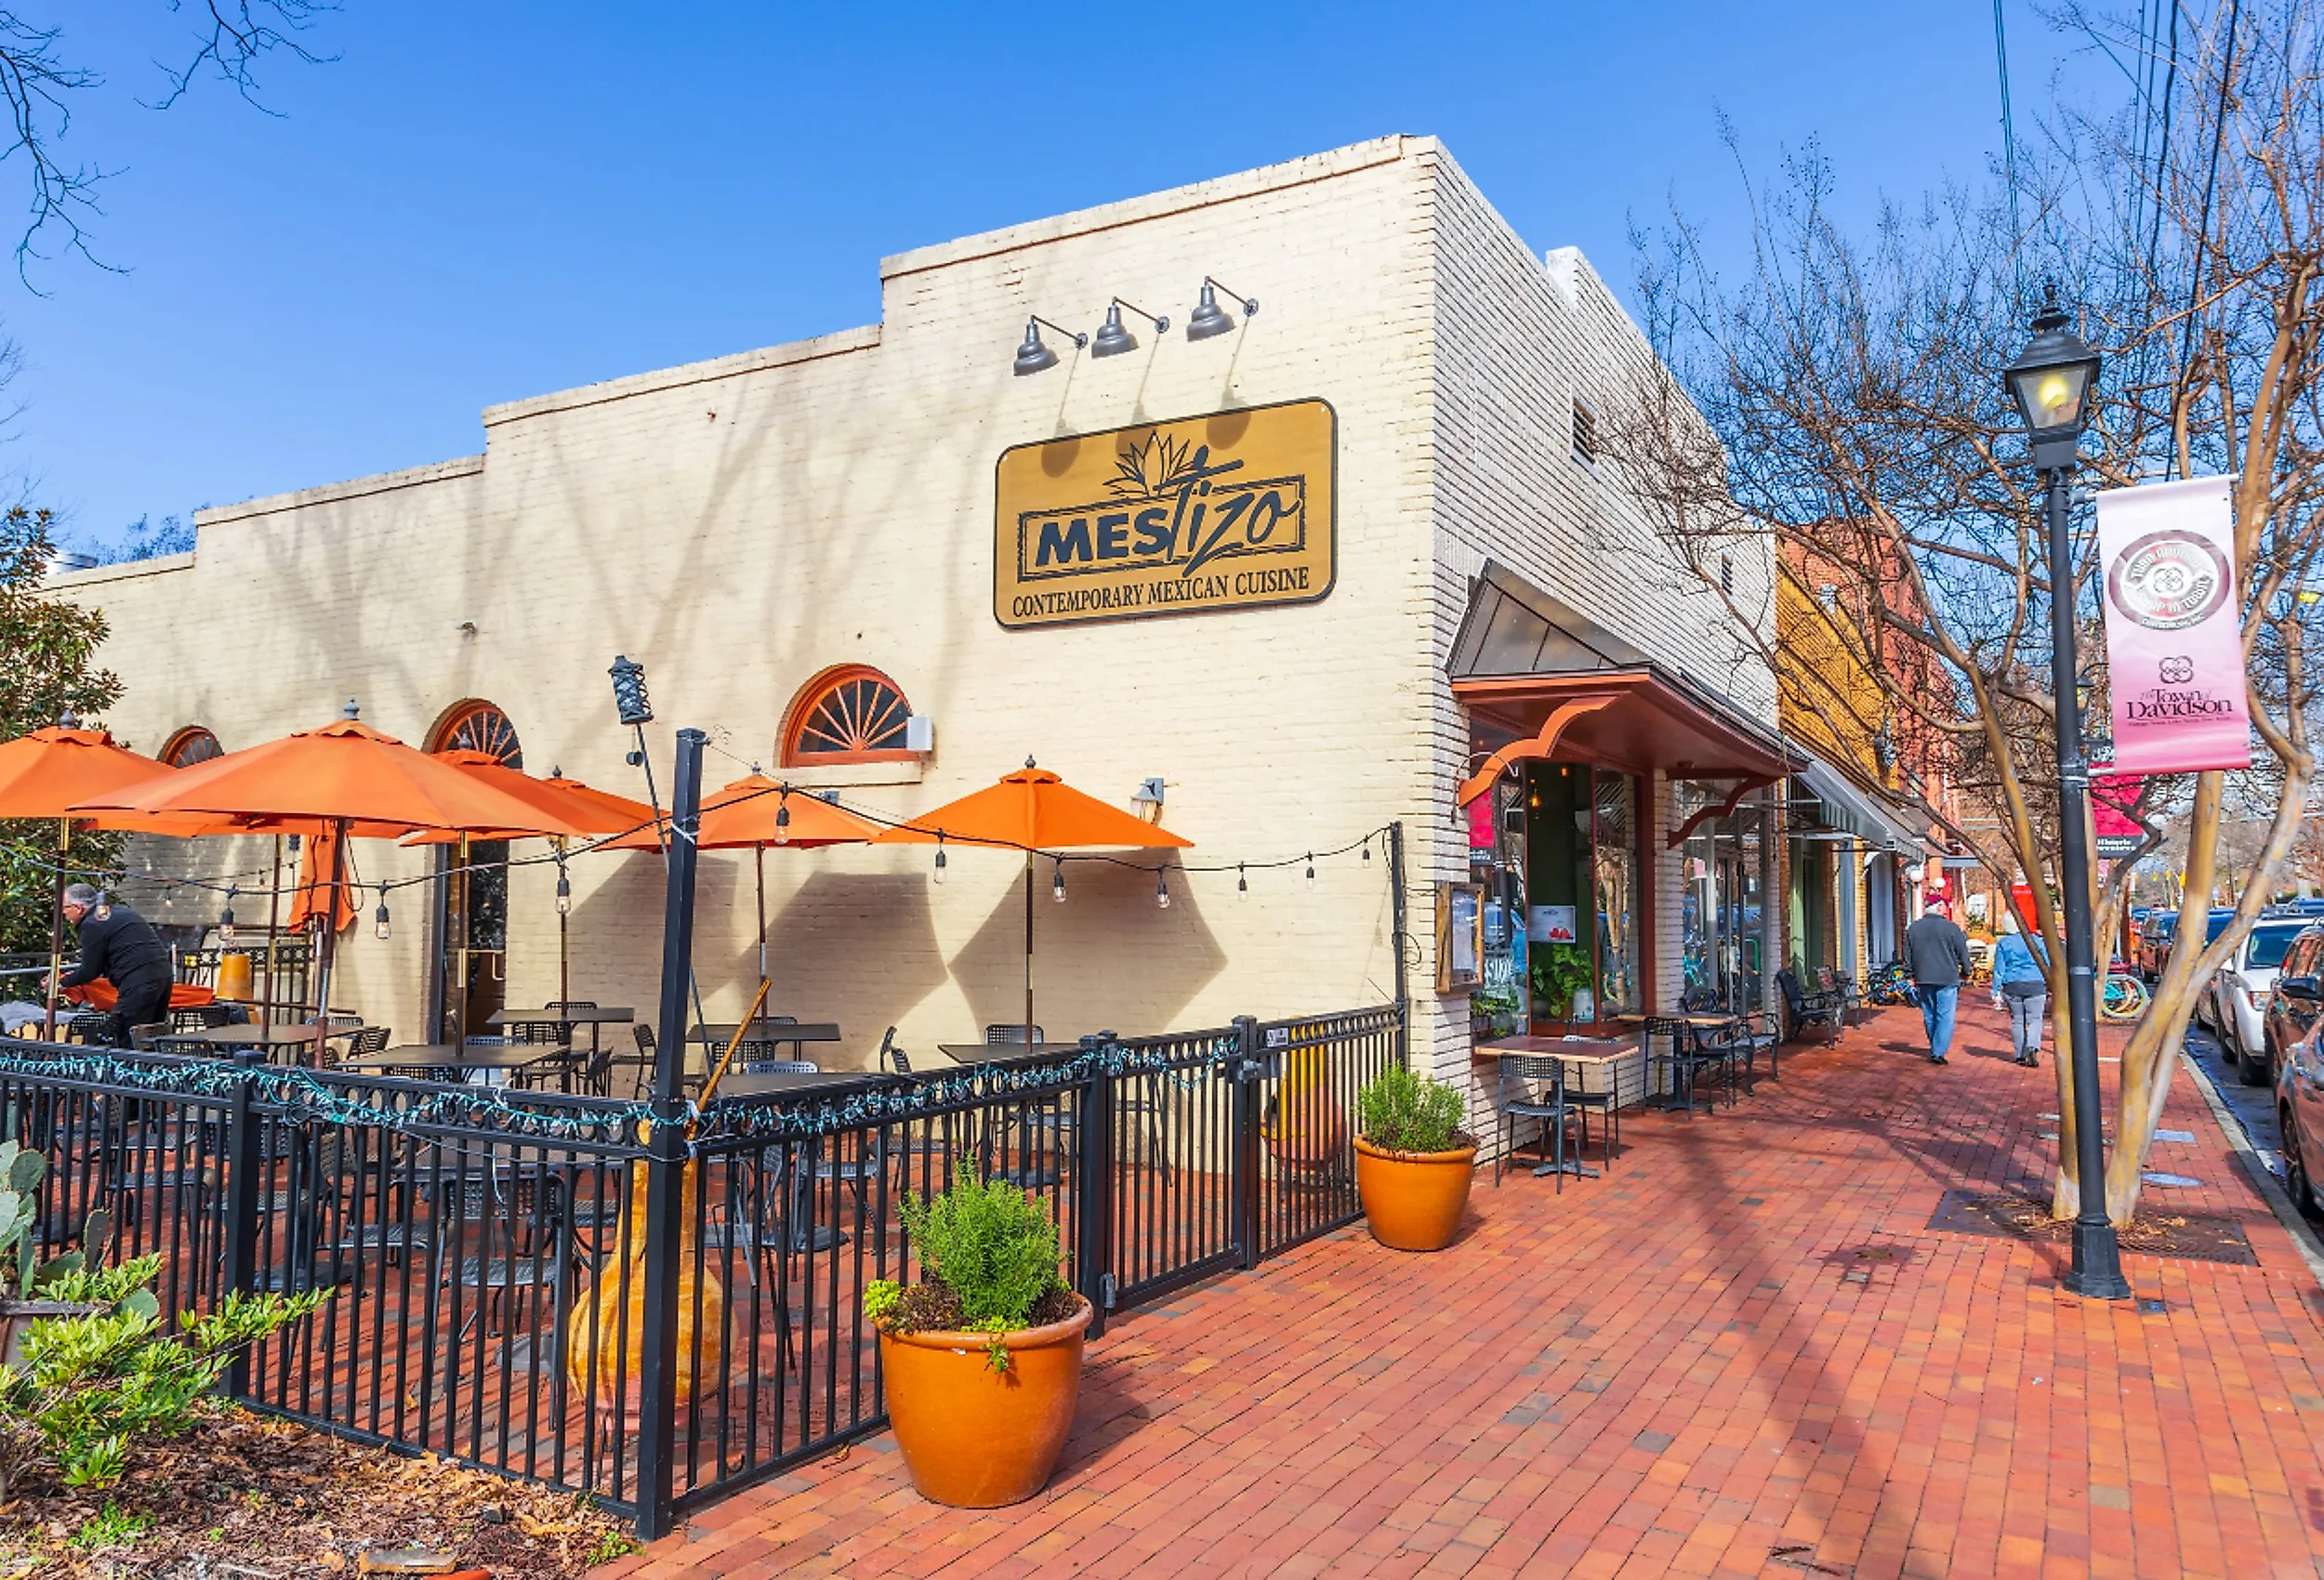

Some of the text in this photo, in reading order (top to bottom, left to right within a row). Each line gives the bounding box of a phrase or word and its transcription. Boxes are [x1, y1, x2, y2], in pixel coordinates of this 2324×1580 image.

[1013, 567, 1309, 617] CONTEMPORARY MEXICAN CUISINE
[2151, 688, 2202, 703] Town
[2126, 699, 2233, 719] Davidson
